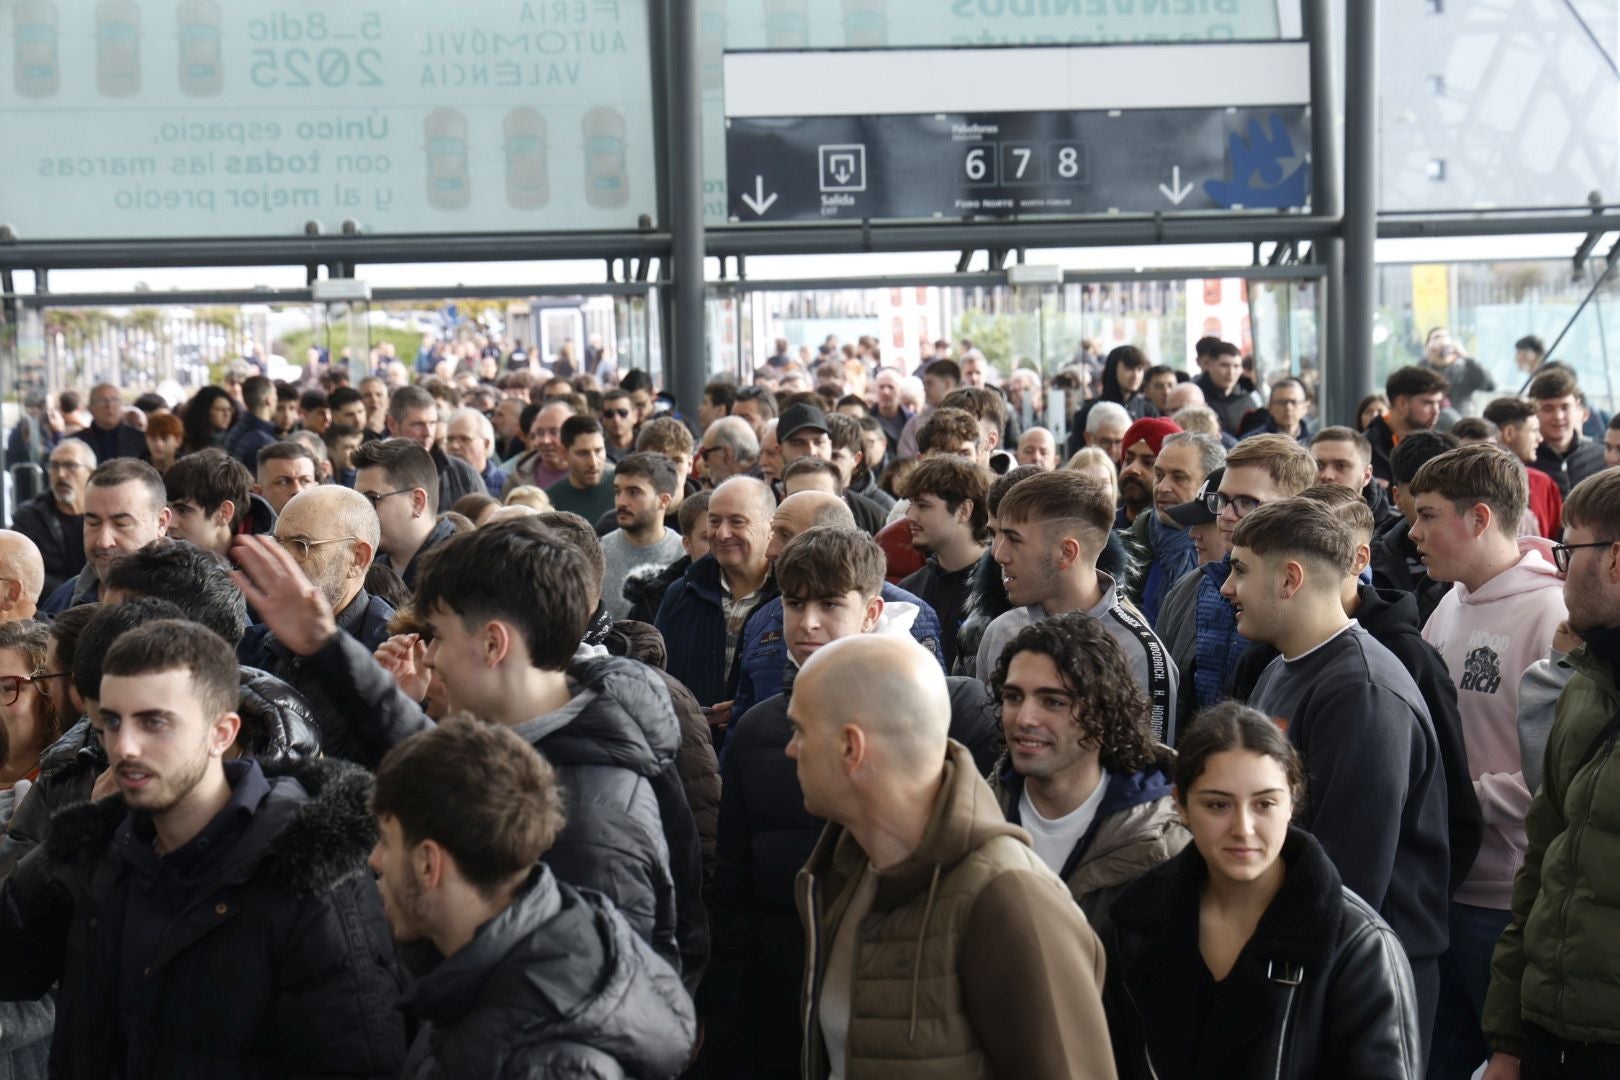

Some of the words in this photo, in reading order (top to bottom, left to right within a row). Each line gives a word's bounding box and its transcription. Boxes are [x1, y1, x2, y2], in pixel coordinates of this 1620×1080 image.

[965, 149, 986, 180] 6
[1011, 148, 1032, 180] 7
[1058, 146, 1079, 178] 8
[820, 193, 855, 206] Salida
[1468, 629, 1511, 652] HOOD
[1460, 672, 1501, 694] RICH
